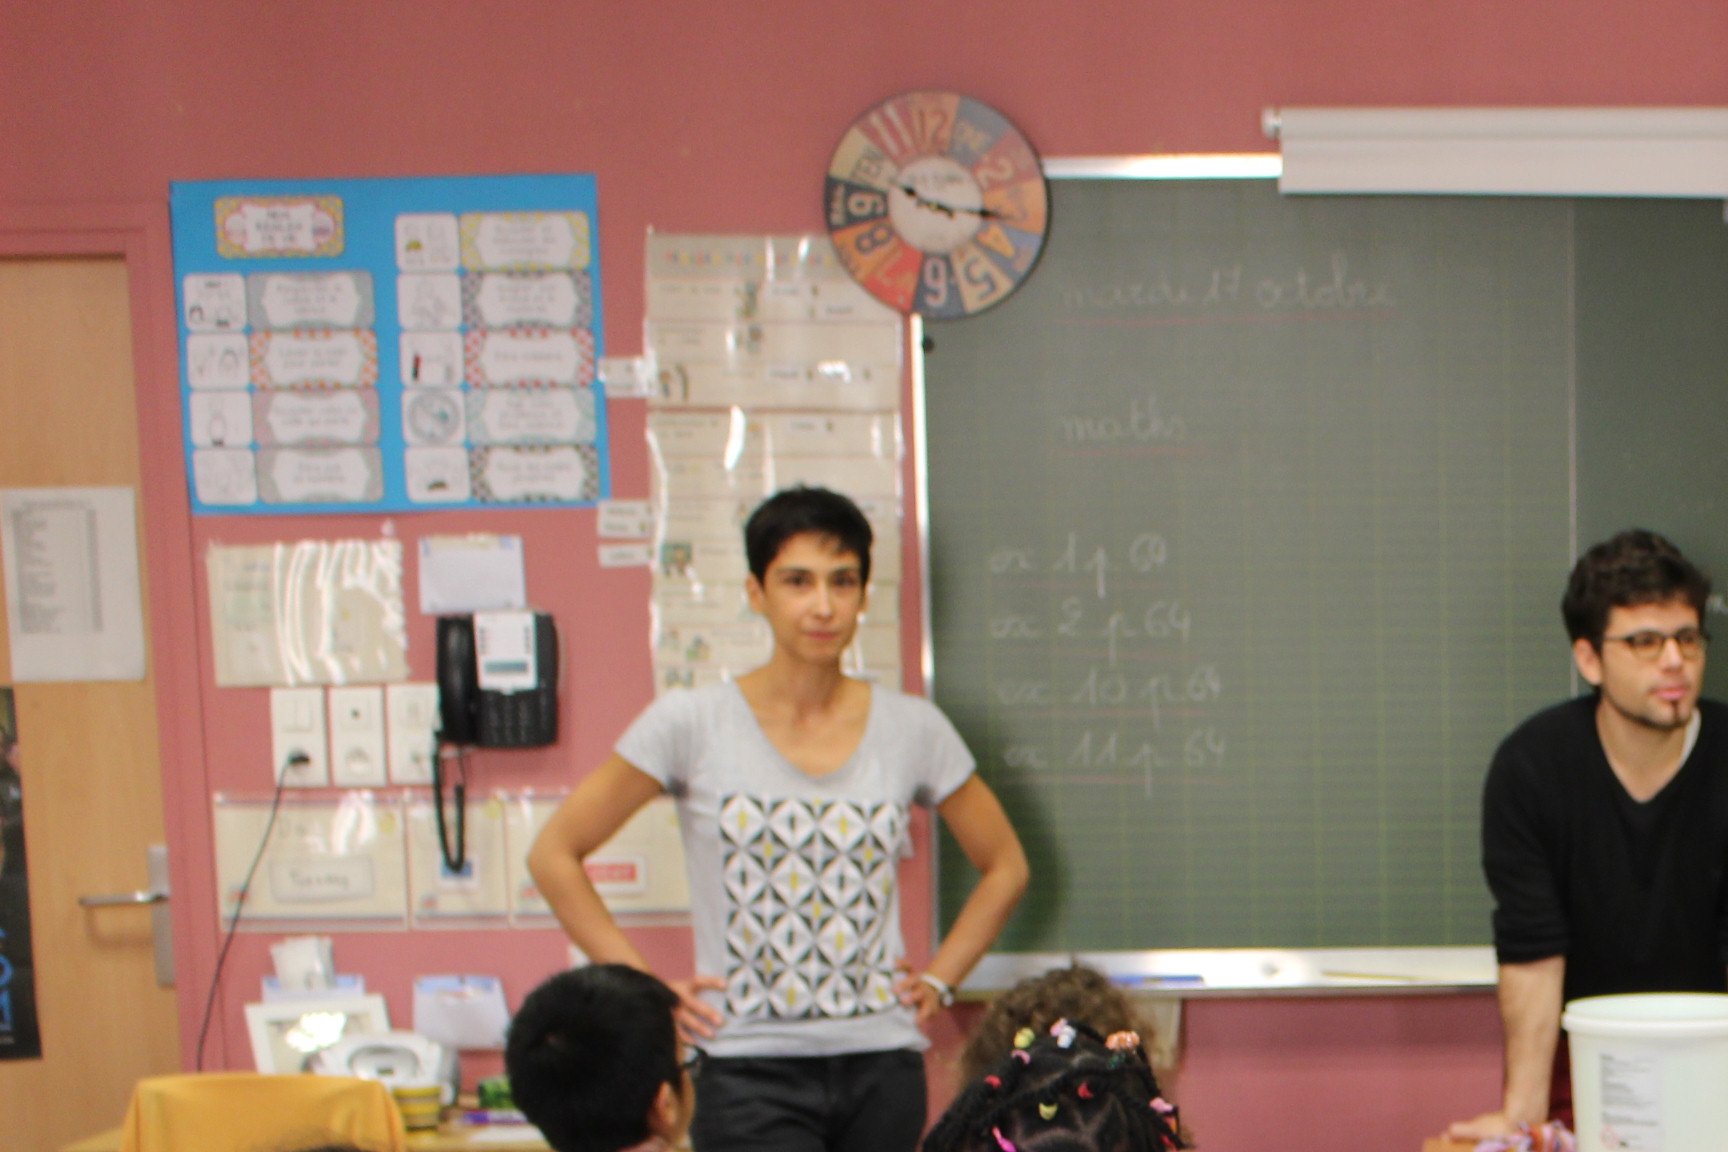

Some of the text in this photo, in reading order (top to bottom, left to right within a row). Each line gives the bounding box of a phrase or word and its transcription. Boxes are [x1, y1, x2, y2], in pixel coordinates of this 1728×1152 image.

[854, 222, 894, 255] 8
[1058, 394, 1187, 443] maths
[1143, 600, 1193, 643] 64
[1072, 667, 1127, 705] 10
[1067, 730, 1118, 766] 11
[1183, 727, 1227, 767] 64
